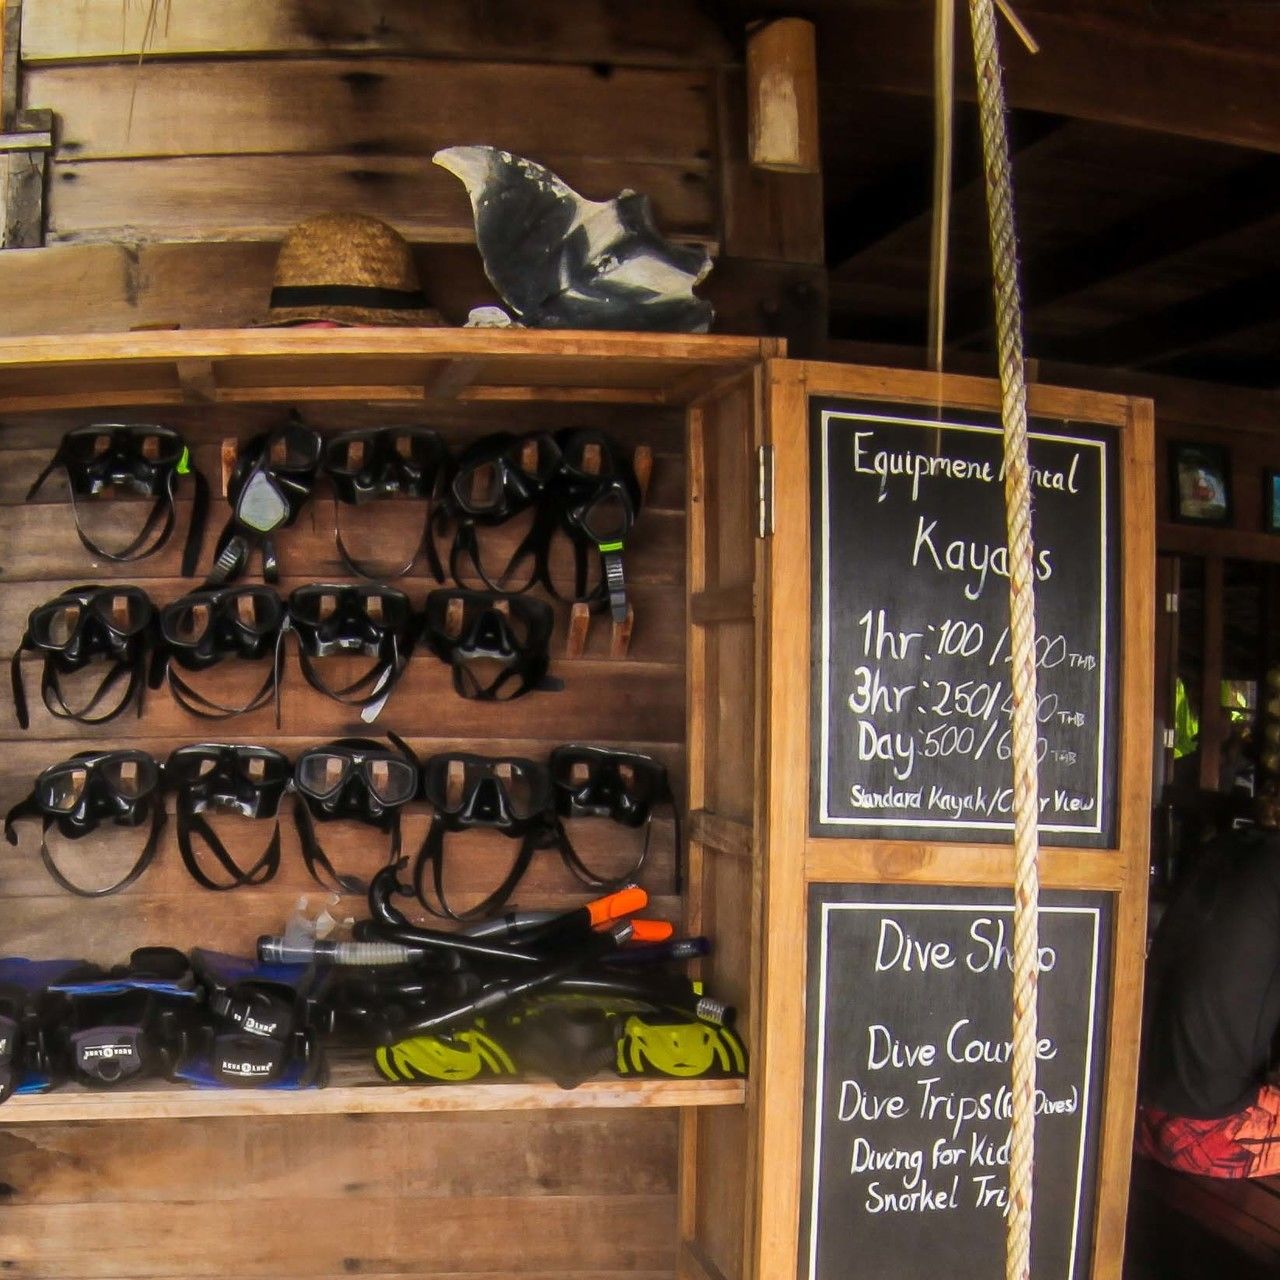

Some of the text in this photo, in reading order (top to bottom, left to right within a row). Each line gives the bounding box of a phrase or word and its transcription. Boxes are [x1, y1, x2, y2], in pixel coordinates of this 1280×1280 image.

[855, 432, 992, 503] Equipment
[913, 516, 1052, 600] Kayas
[850, 785, 924, 809] Standard
[1055, 789, 1095, 812] View
[875, 918, 956, 973] Dive
[867, 1018, 1057, 1071] Dive Coure
[838, 1080, 909, 1122] Dive
[850, 1126, 1012, 1187] Diving for Kid
[865, 1175, 959, 1213] Snorkel
